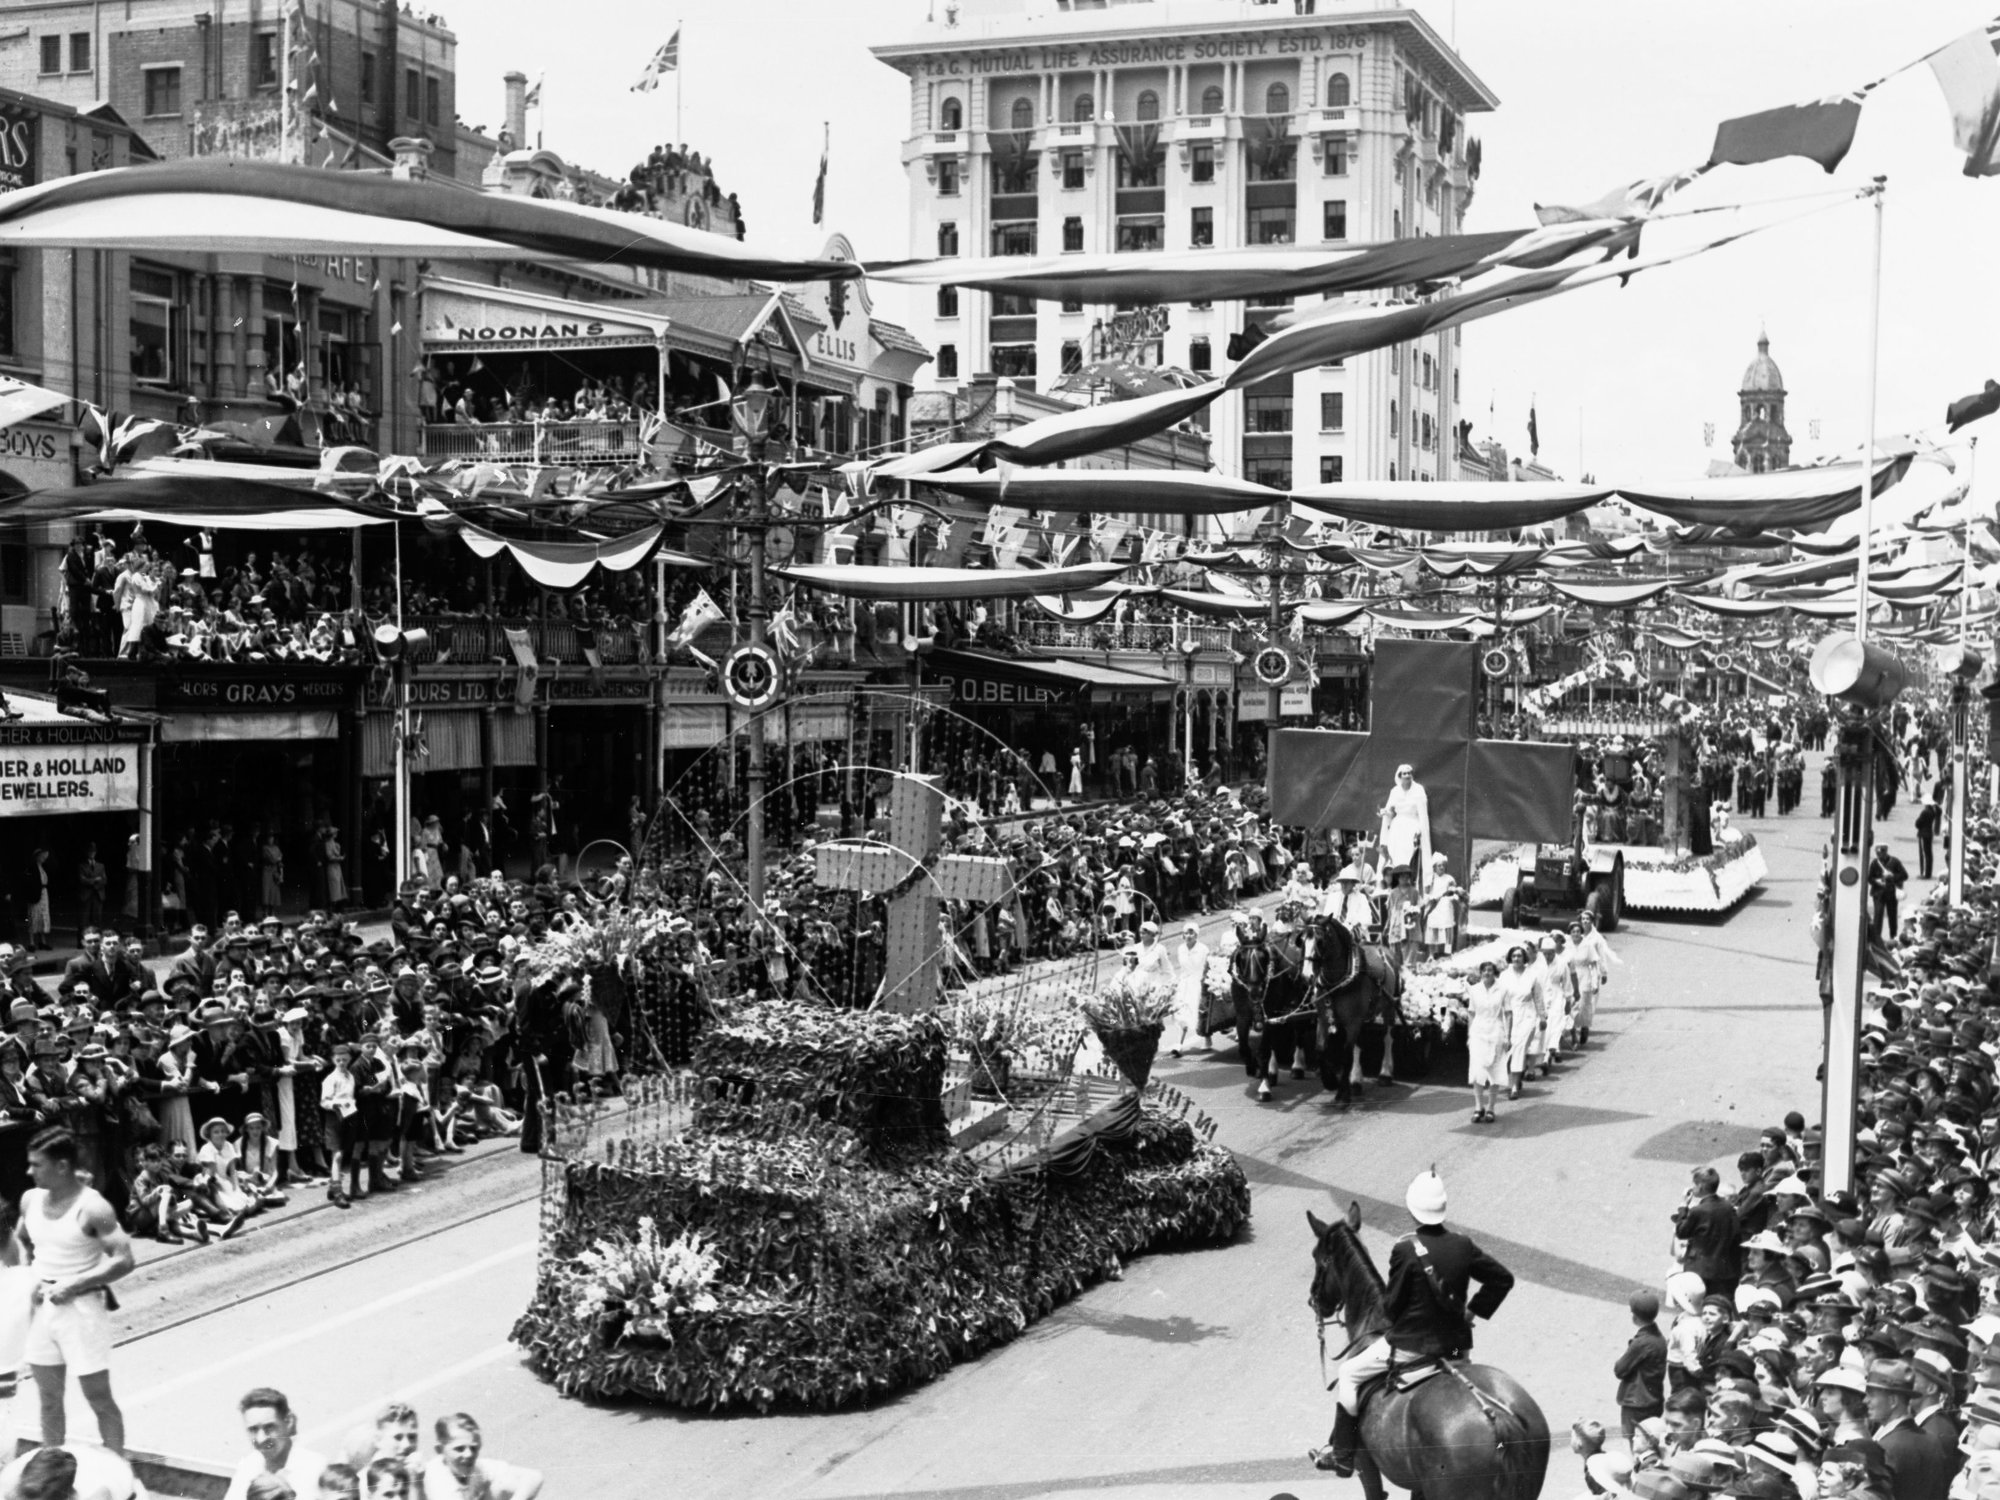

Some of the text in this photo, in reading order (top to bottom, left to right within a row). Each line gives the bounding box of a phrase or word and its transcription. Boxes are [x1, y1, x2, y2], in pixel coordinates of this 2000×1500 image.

[970, 55, 1034, 74] MUTUAL
[1042, 51, 1080, 69] LIFE
[1088, 43, 1186, 66] ASSURANCE
[1330, 32, 1367, 50] 1876
[817, 332, 856, 362] ELLIS
[226, 683, 296, 703] GRAYS
[457, 680, 488, 701] LTD.
[48, 727, 115, 744] HOLLAND
[33, 762, 44, 778] &
[46, 757, 127, 777] HOLLAND
